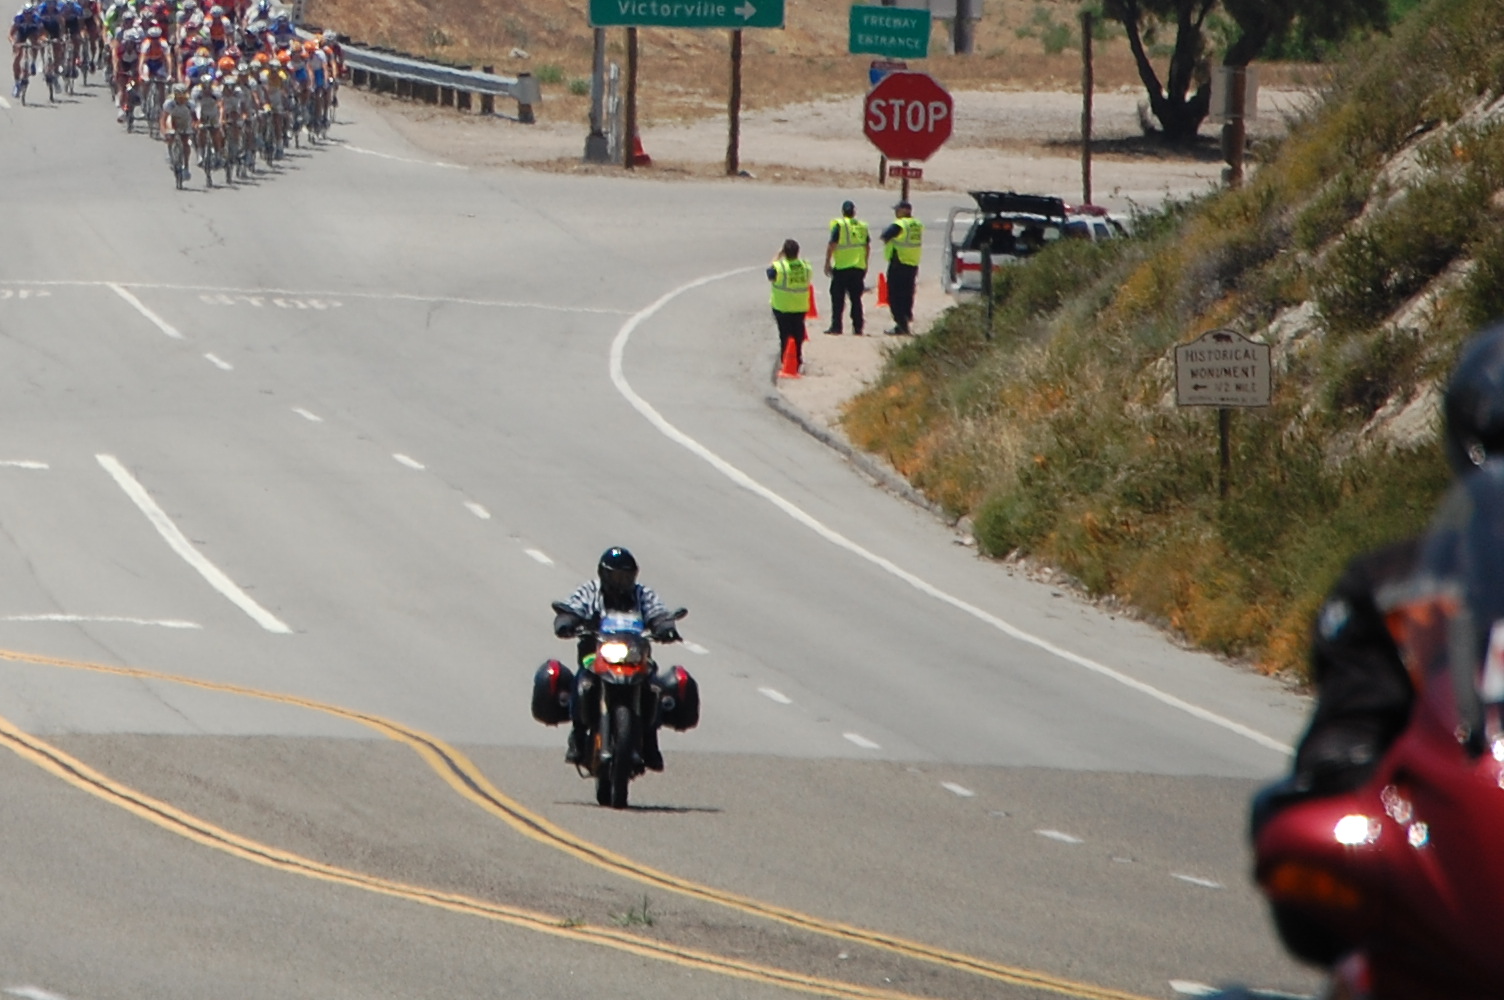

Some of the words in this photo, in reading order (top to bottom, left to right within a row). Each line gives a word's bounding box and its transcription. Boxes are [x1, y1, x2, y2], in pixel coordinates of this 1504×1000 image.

[617, 0, 726, 18] Victorville
[862, 14, 918, 29] FREEWAY
[857, 33, 922, 49] ENTRANCE
[868, 98, 948, 133] STOP
[1185, 348, 1259, 362] HISTORICAL
[1190, 365, 1257, 379] MONUMENT
